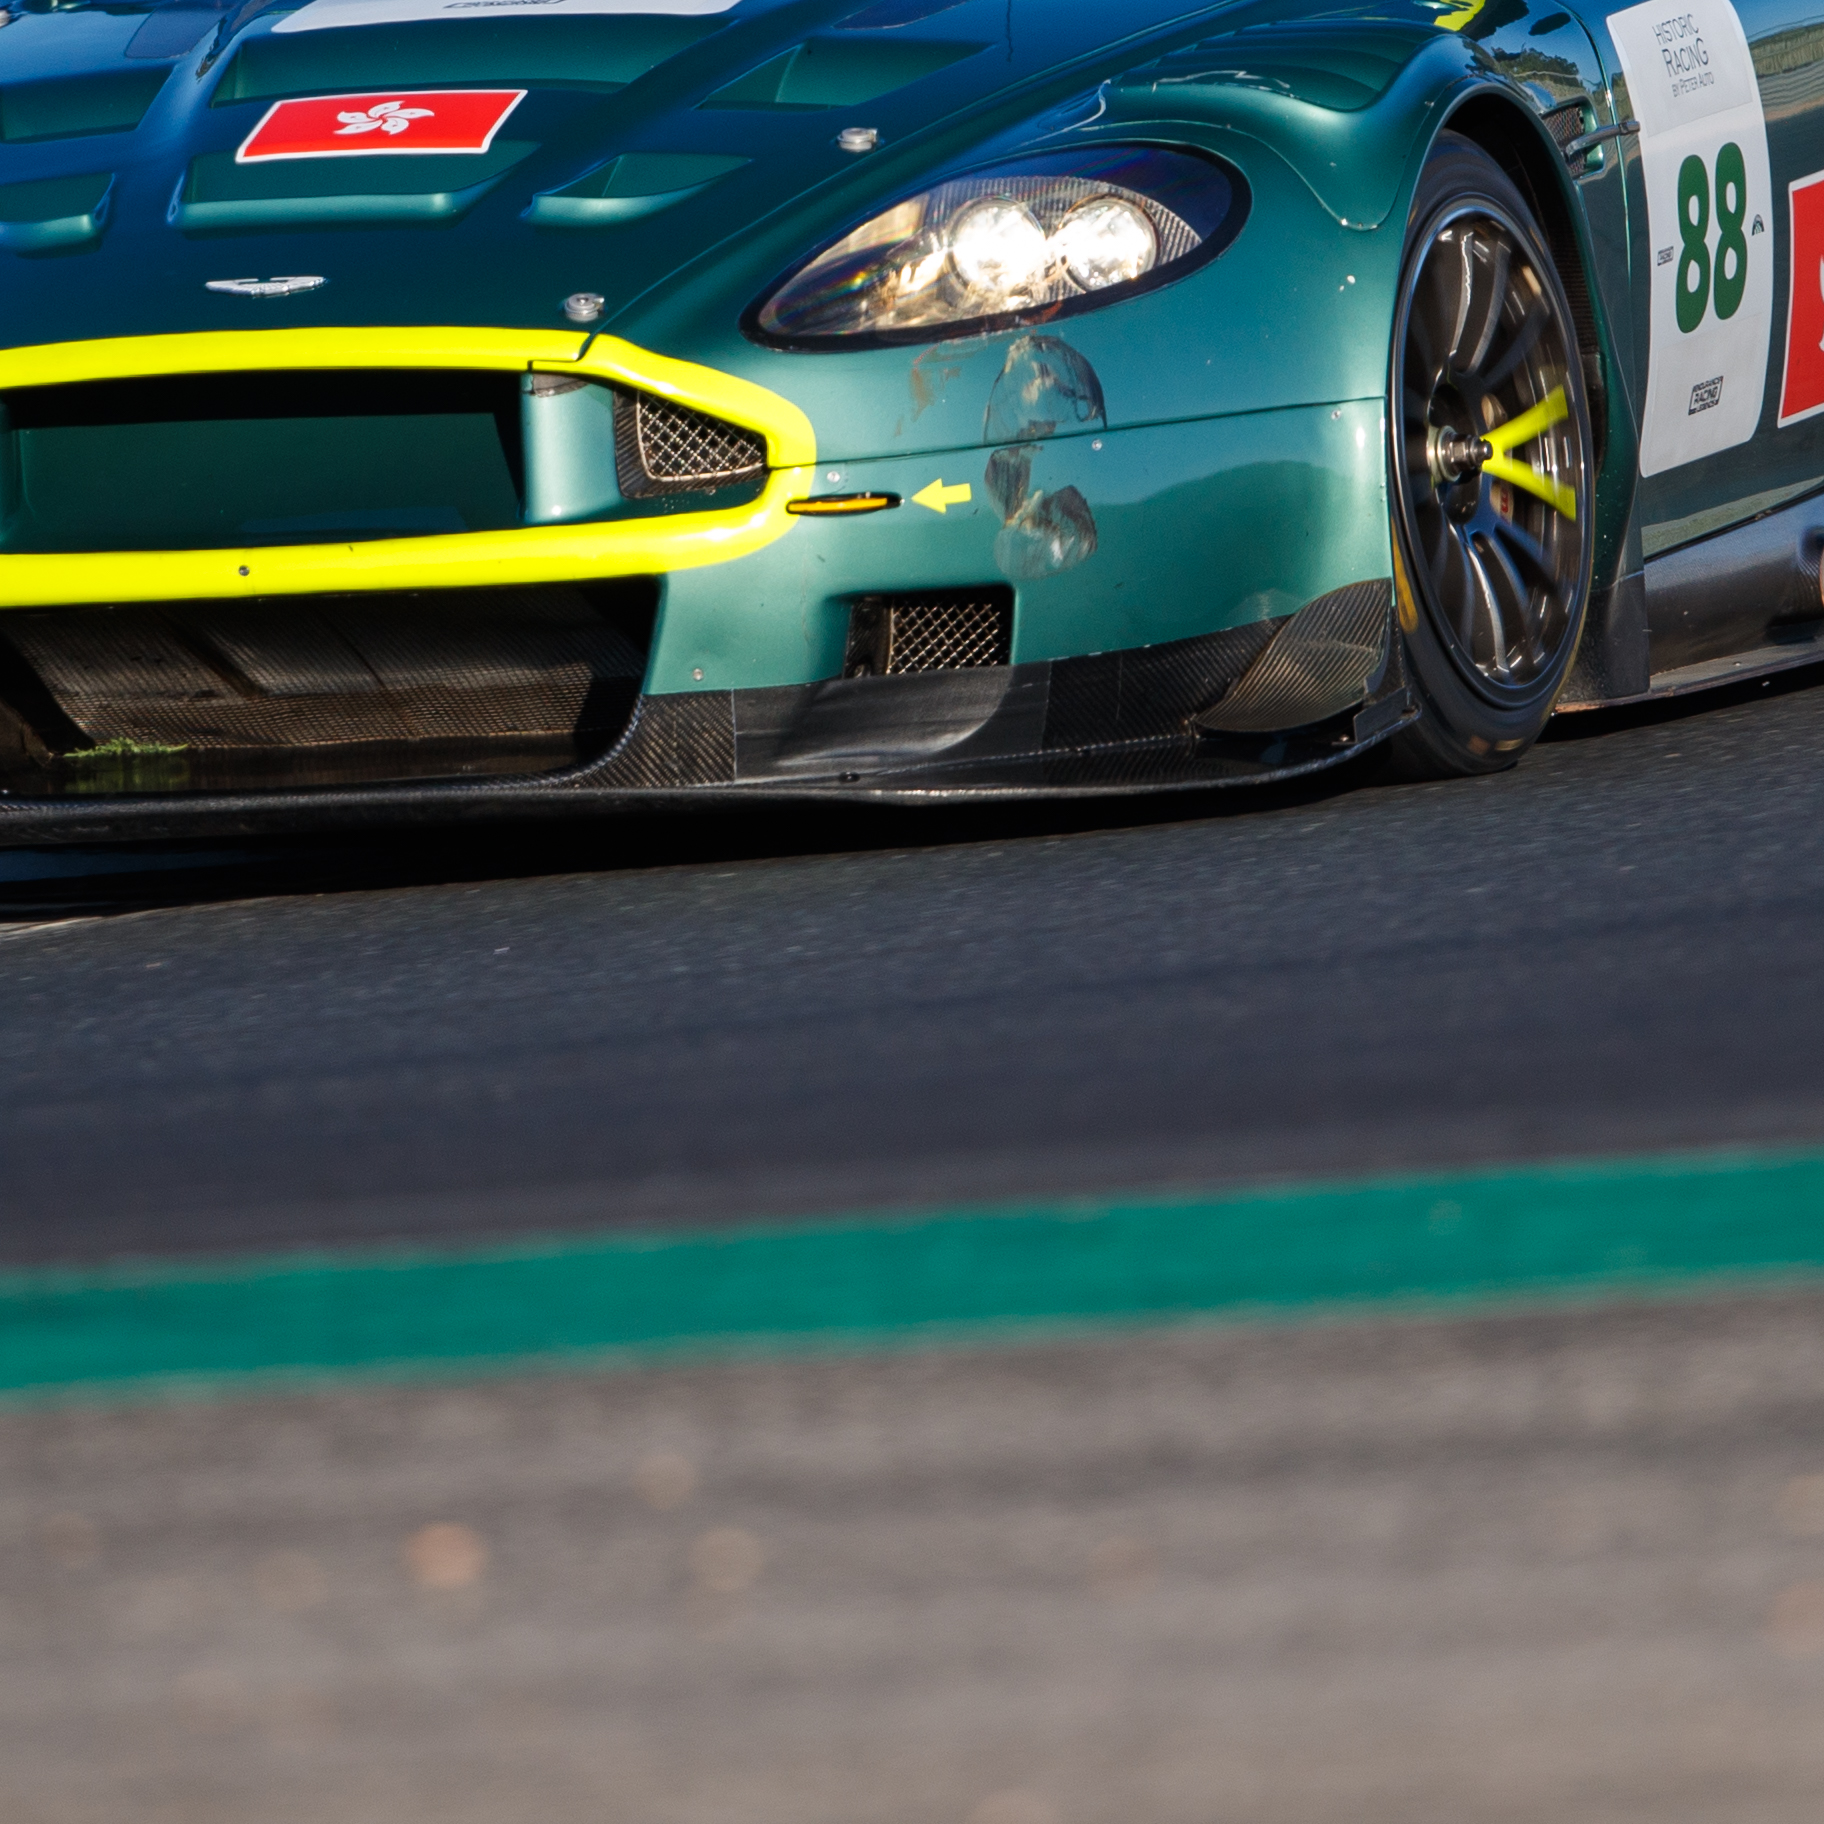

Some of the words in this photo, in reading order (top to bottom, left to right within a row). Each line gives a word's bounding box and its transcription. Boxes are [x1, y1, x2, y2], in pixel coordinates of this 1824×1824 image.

[1651, 13, 1700, 46] HISTORIC
[1661, 37, 1710, 78] RACING
[1675, 142, 1747, 333] 88
